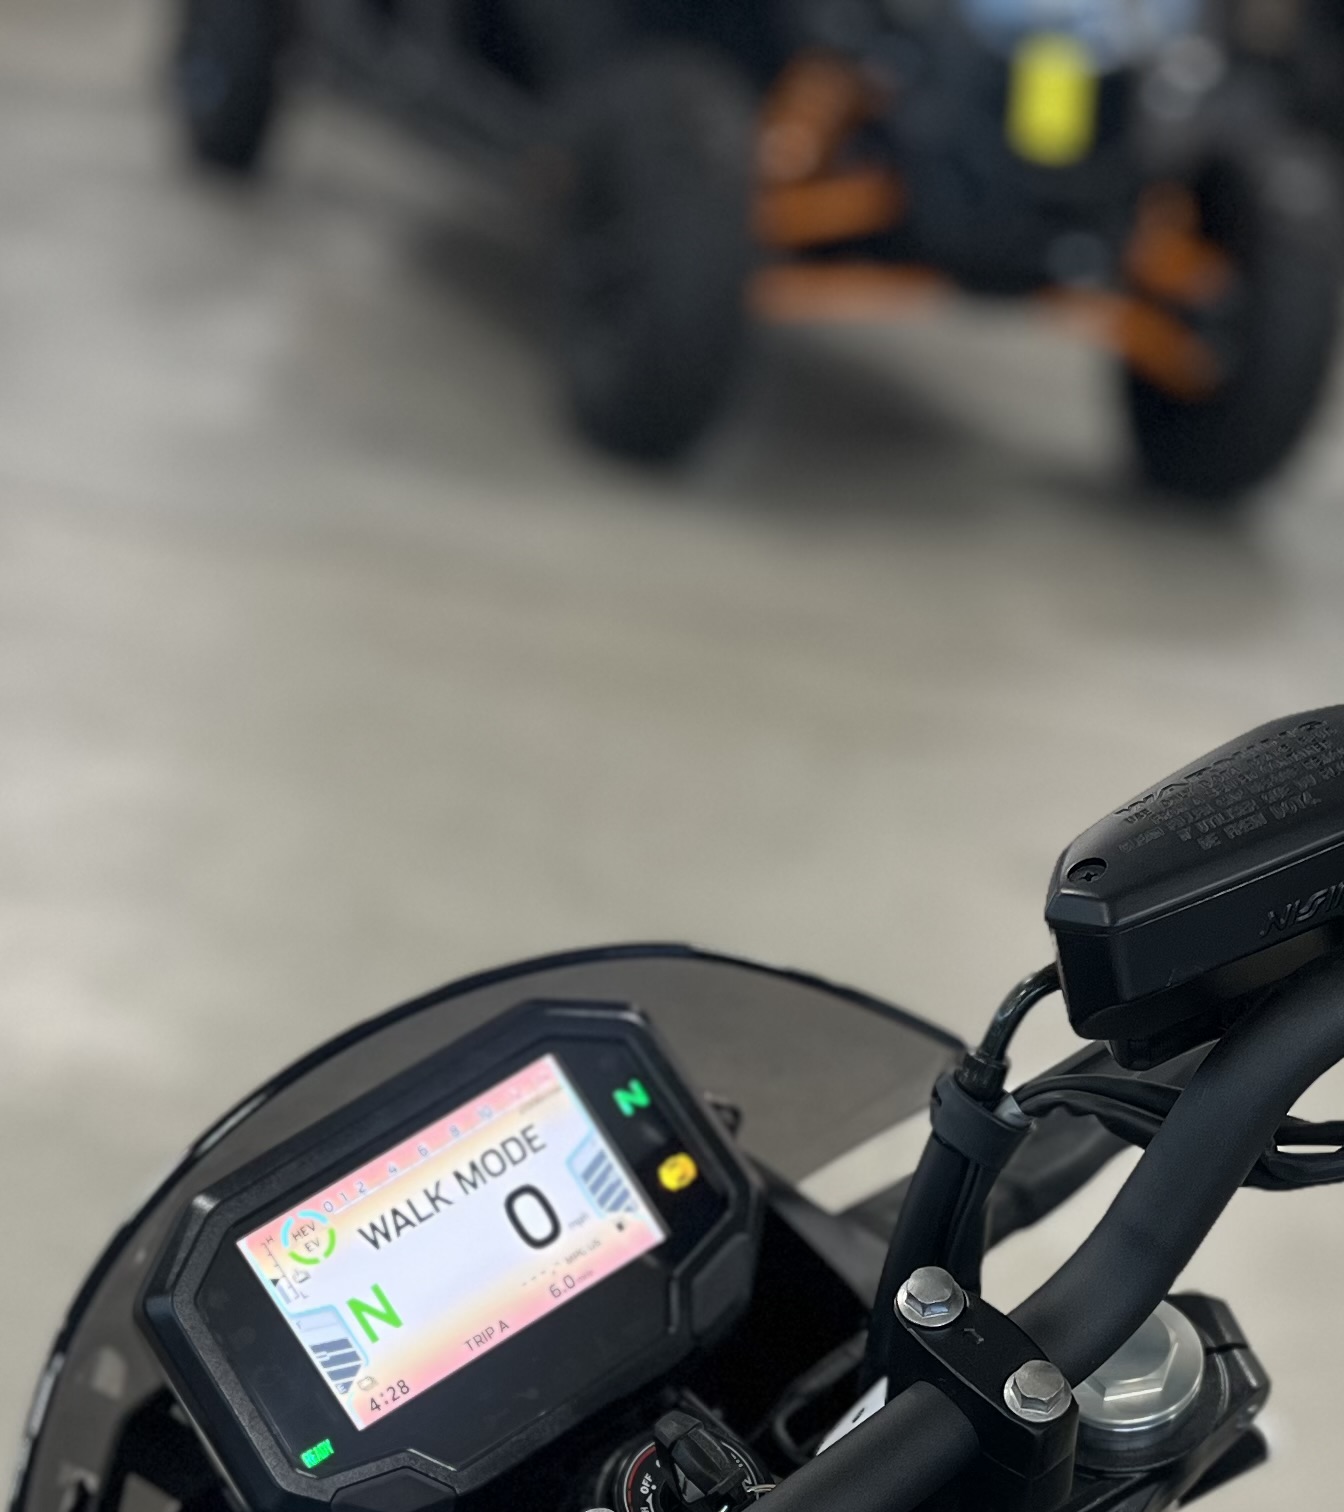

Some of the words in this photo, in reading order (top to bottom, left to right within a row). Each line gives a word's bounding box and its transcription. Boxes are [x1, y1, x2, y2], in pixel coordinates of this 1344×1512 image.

[613, 1079, 651, 1117] N
[358, 1182, 453, 1249] WALK
[454, 1124, 546, 1193] MODE
[291, 1220, 316, 1241] HEV
[504, 1184, 562, 1250] 0
[304, 1237, 321, 1252] EV
[549, 1275, 577, 1298] 6.0
[347, 1283, 403, 1343] N
[465, 1327, 497, 1351] TRIP
[497, 1319, 510, 1332] A
[369, 1379, 410, 1412] 4:28
[301, 1439, 334, 1468] READY
[639, 1472, 653, 1494] OFF
